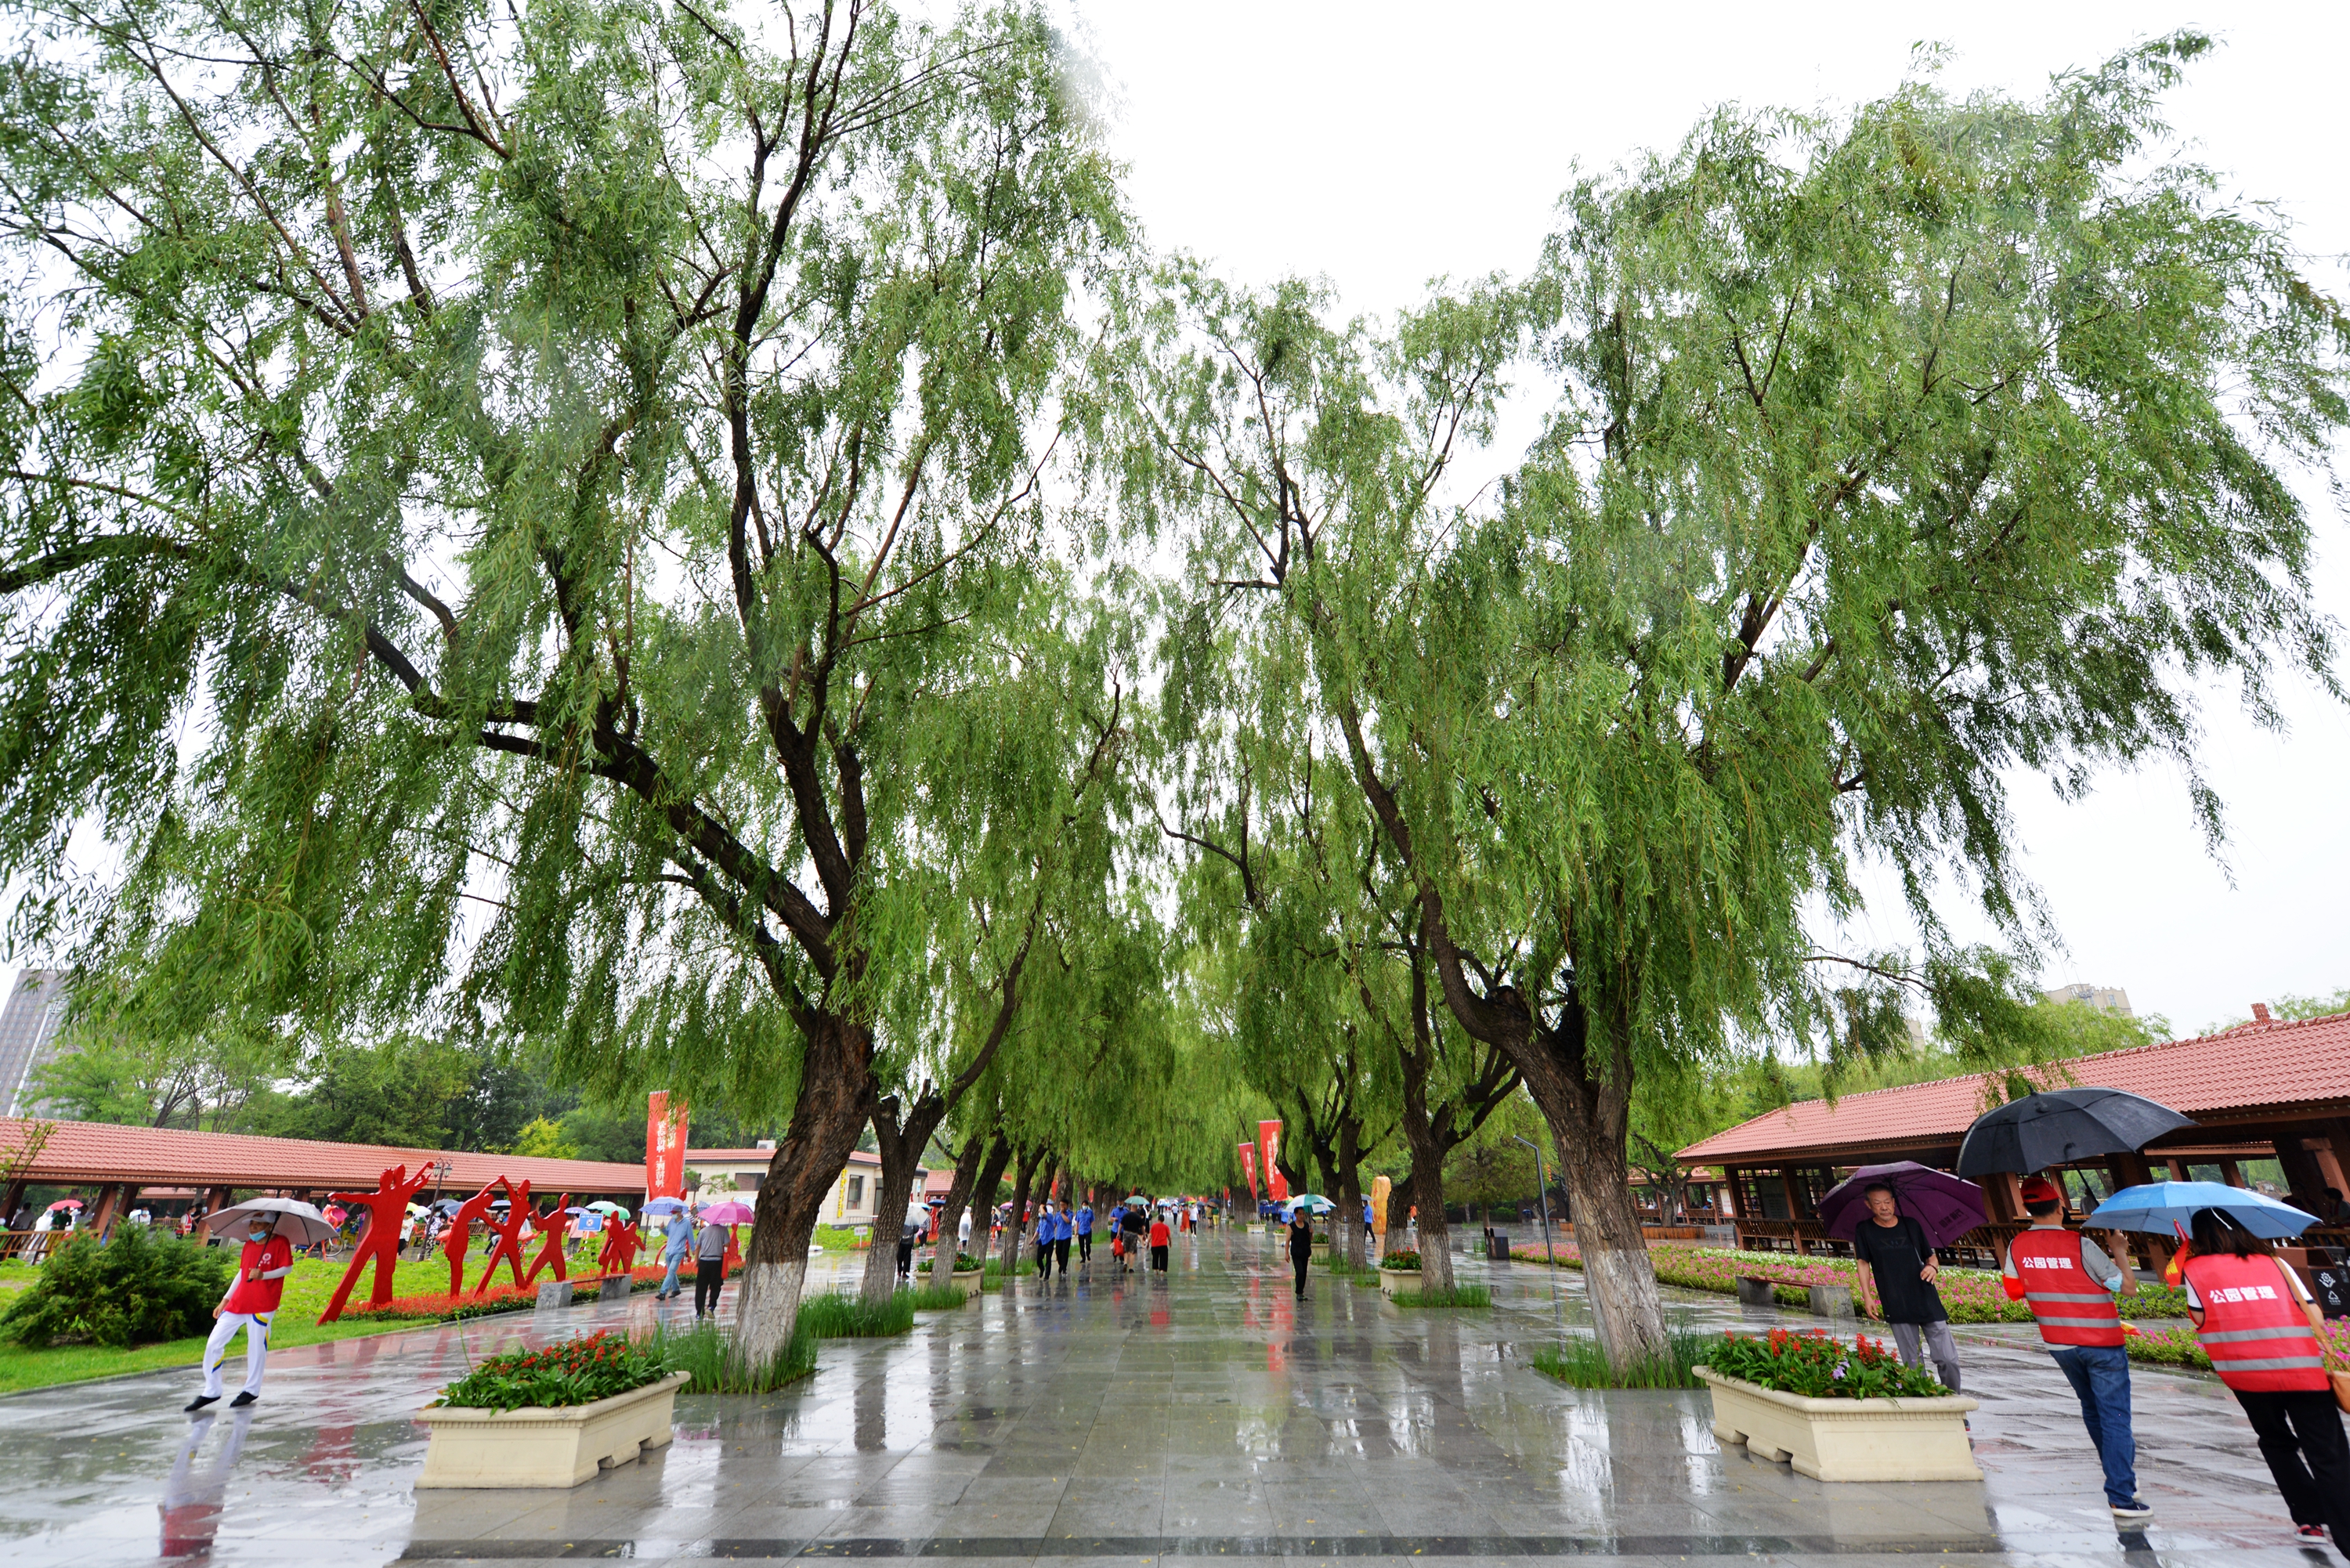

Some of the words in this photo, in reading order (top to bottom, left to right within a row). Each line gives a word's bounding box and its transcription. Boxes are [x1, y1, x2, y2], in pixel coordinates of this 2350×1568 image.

[2023, 1257, 2073, 1269] 公园管理
[2209, 1285, 2278, 1304] 公园管理
